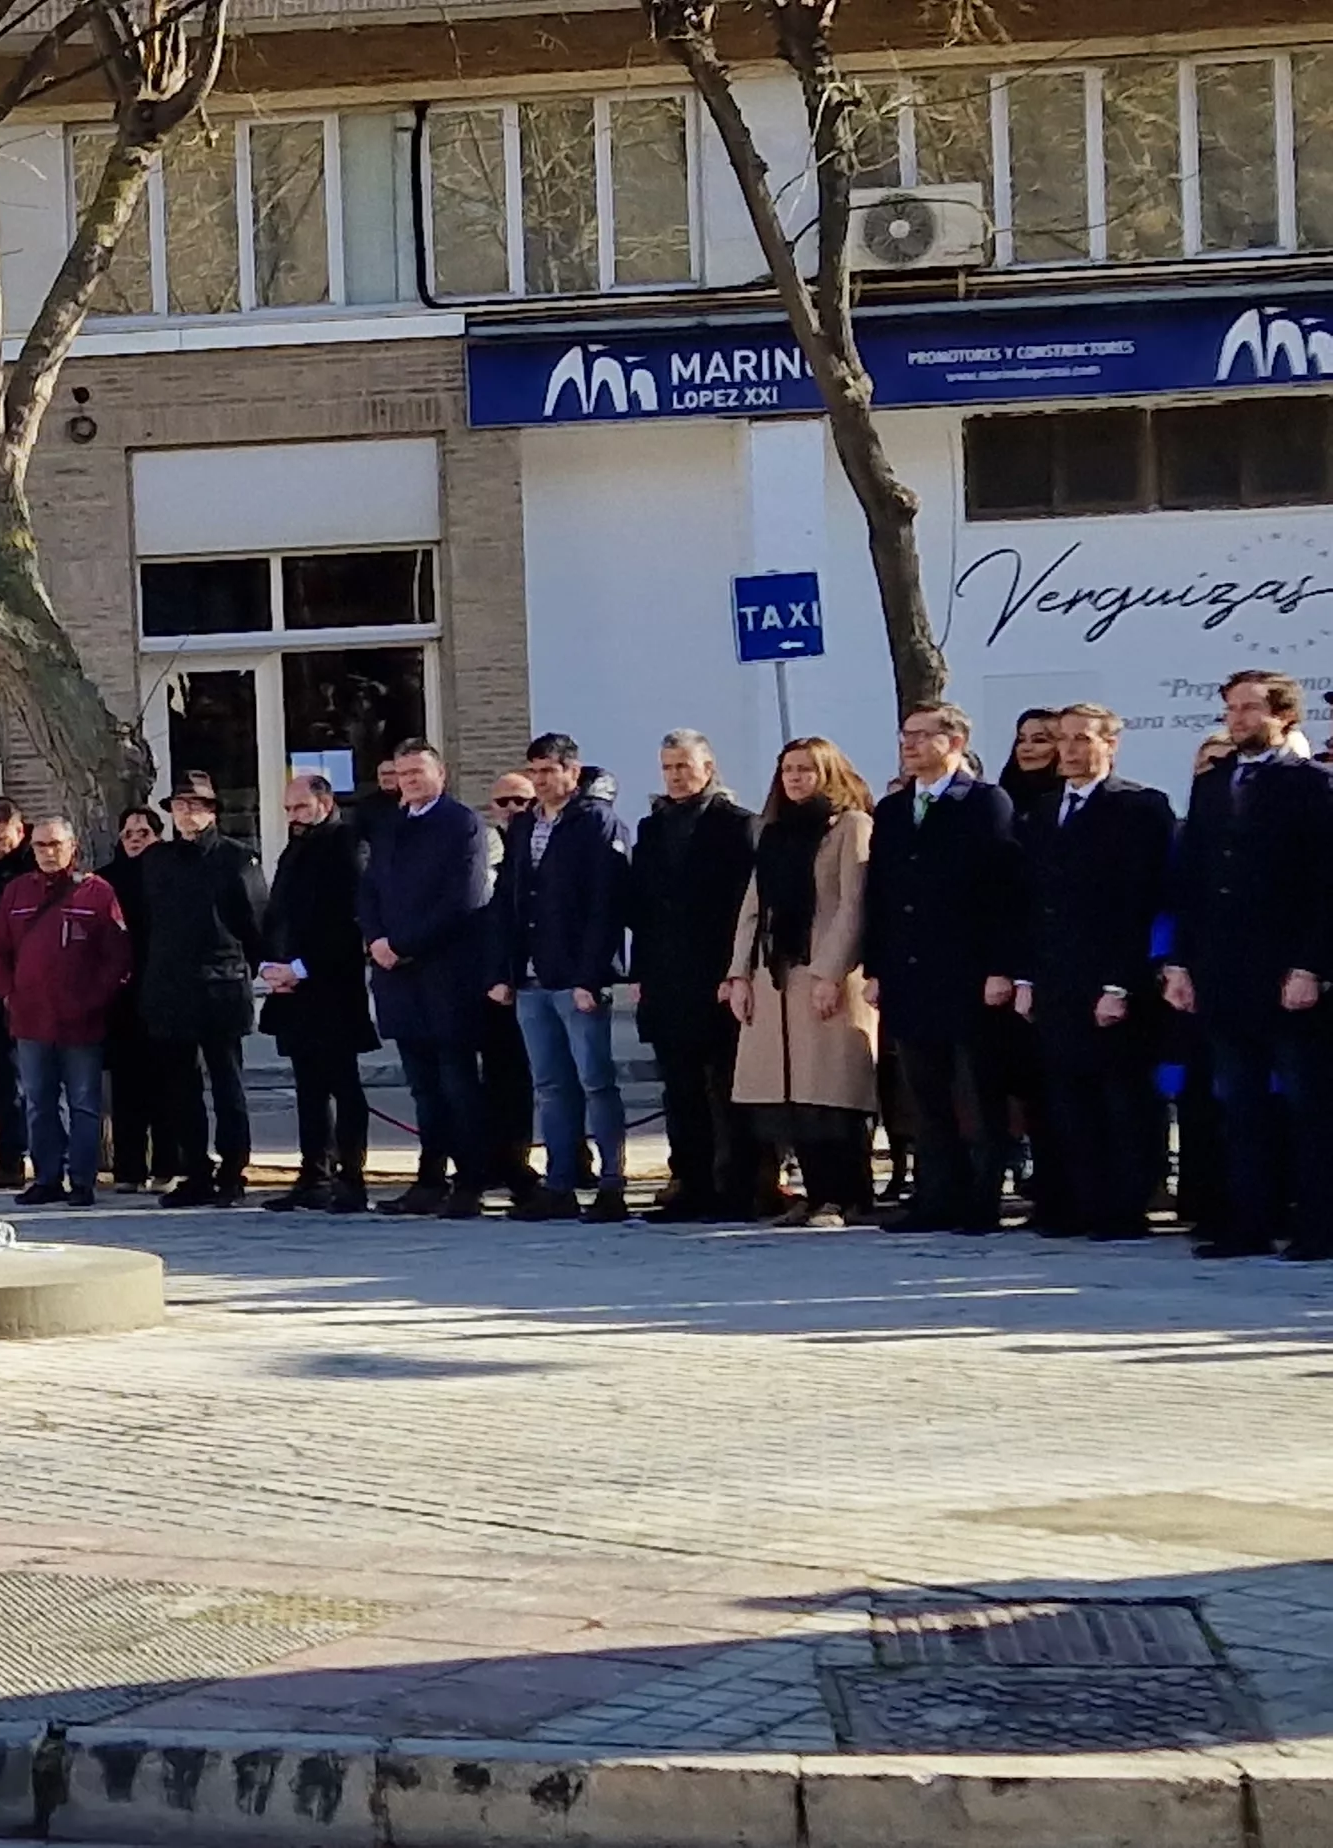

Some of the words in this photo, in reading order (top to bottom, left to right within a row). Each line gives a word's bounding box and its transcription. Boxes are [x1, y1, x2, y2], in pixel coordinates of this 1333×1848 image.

[671, 347, 816, 387] MARIN
[1003, 347, 1014, 359] Y
[671, 388, 740, 410] LOPEZ
[744, 385, 779, 406] XXI
[955, 540, 1333, 648] Verguizas
[738, 600, 820, 632] TAXI
